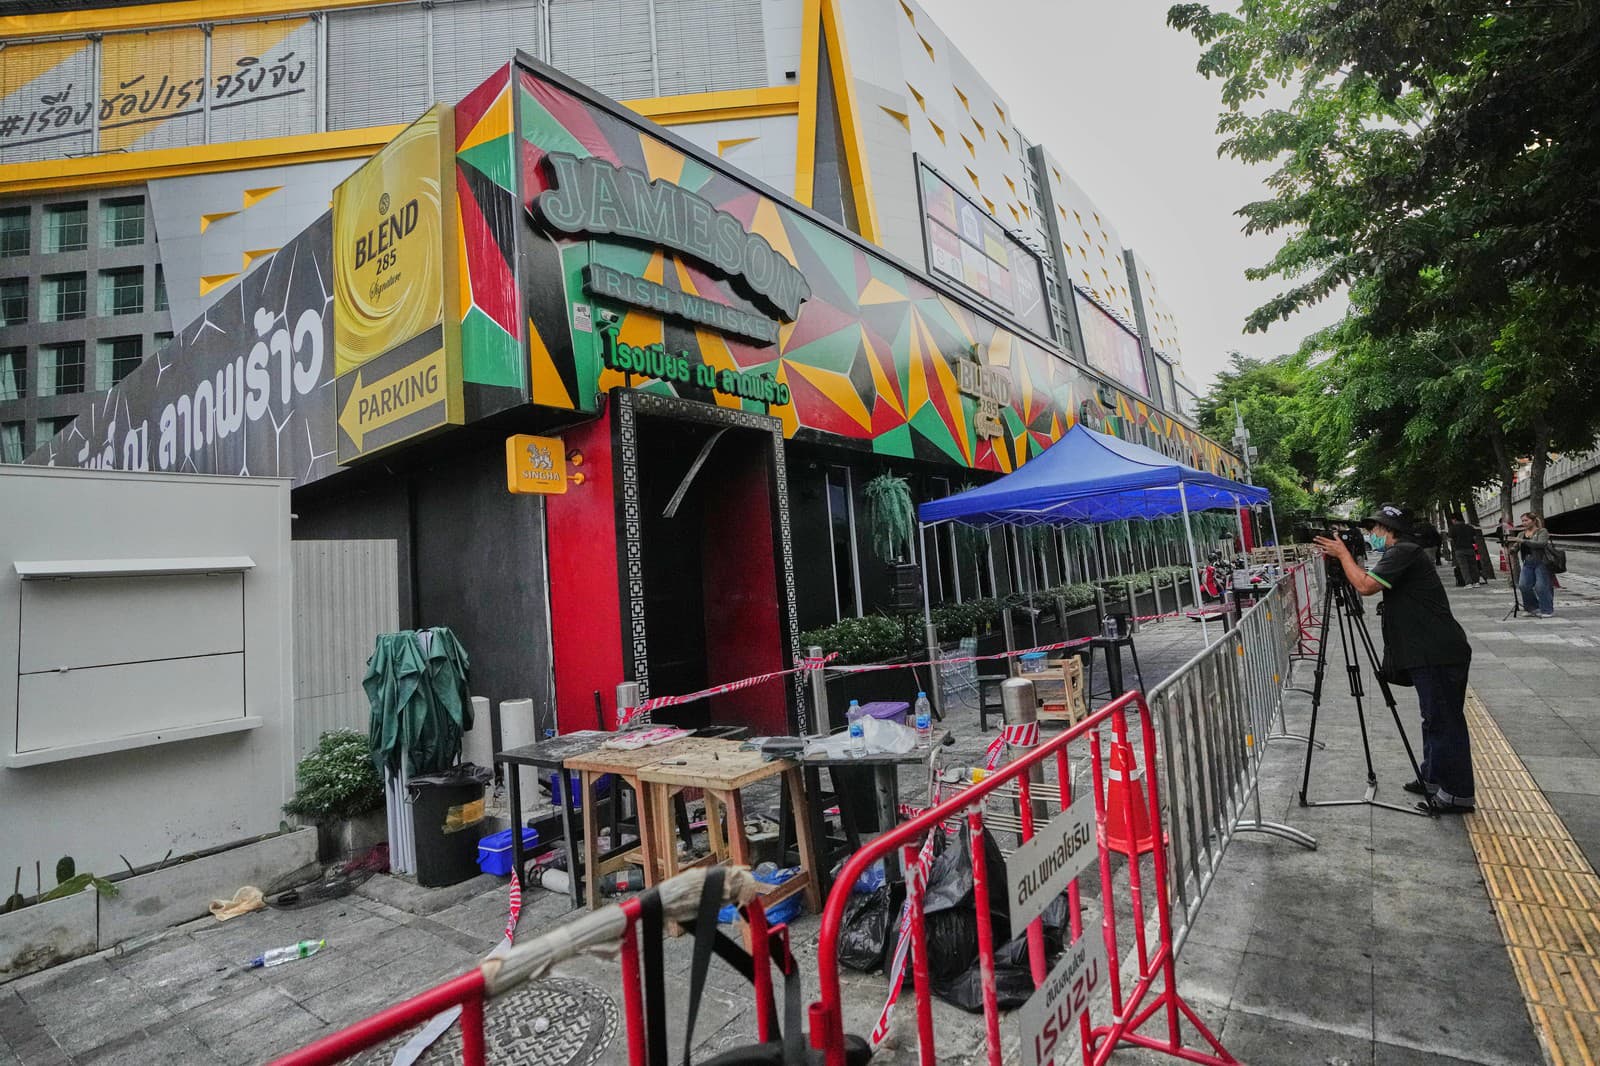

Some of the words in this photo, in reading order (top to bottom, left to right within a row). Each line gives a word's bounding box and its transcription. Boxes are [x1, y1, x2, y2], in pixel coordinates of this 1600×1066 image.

[354, 198, 419, 270] BLEND
[375, 249, 397, 276] 285
[542, 157, 806, 317] JAMESON
[369, 271, 402, 300] Signature
[591, 267, 670, 309] IRISH
[680, 296, 779, 340] WHISKEY
[158, 306, 324, 470] ลาดพร้าว
[358, 364, 439, 425] PARKING
[608, 328, 690, 382] โรงเบียร์
[697, 364, 716, 388] ณ
[722, 373, 791, 405] ลาดพร้าว
[962, 362, 1009, 406] BLEND
[981, 400, 998, 416] 285
[521, 470, 560, 481] SINGHA
[1034, 957, 1098, 1066] ISUZU
